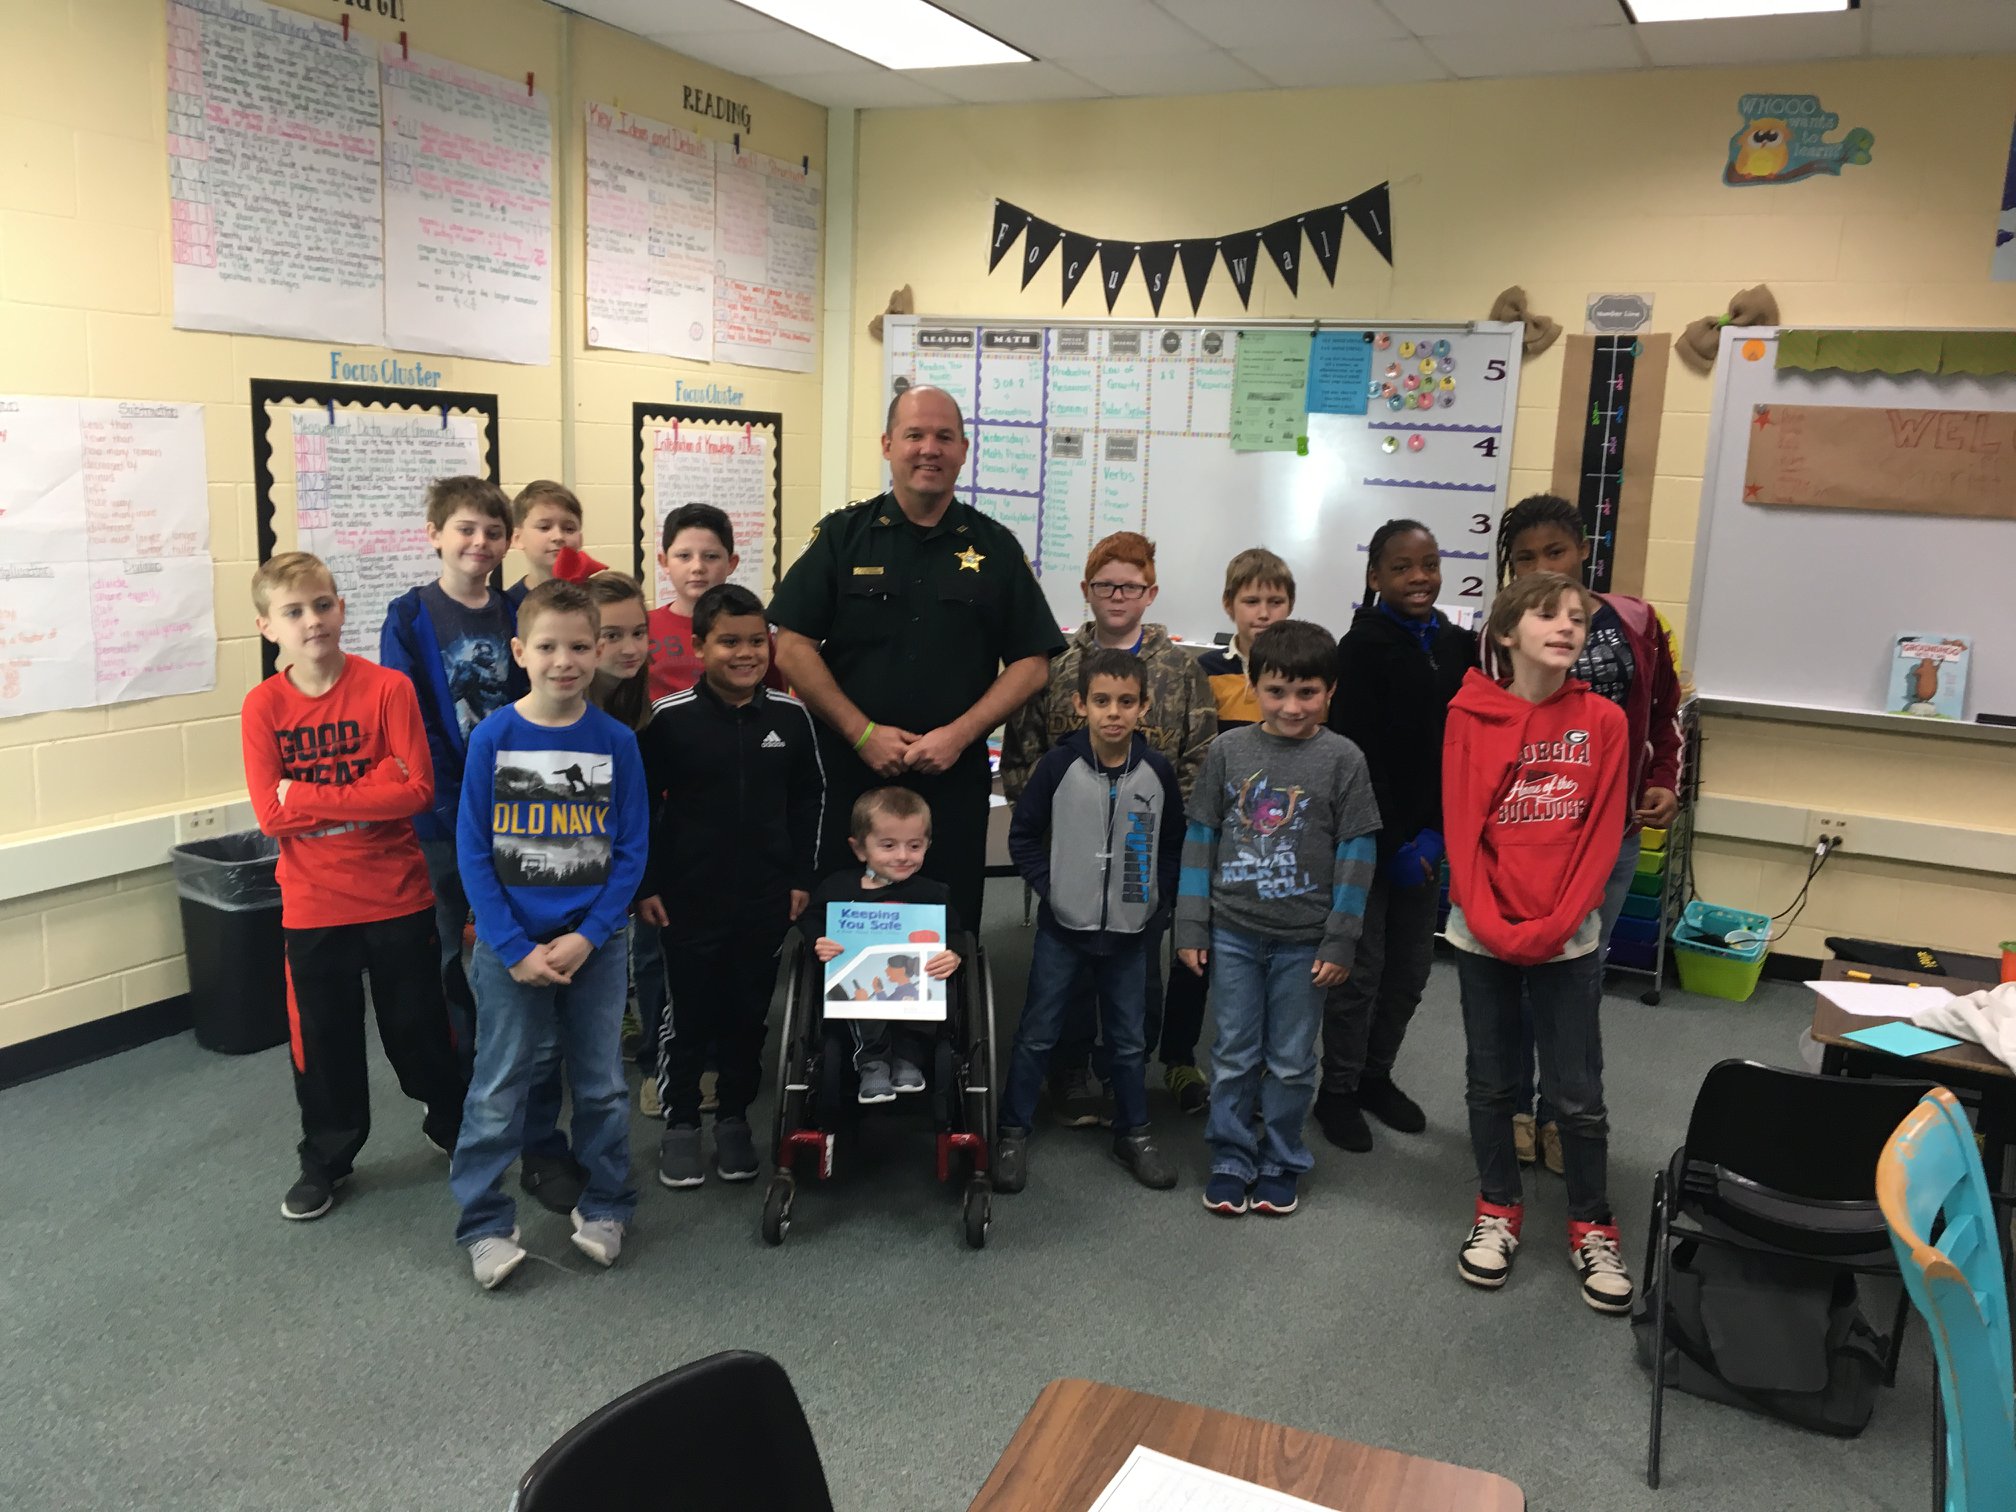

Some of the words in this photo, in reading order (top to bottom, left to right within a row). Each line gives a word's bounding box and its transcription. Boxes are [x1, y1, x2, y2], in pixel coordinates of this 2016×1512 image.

[682, 85, 752, 135] READING
[1742, 97, 1817, 114] WHOOO
[590, 102, 613, 131] Key
[617, 111, 649, 141] Ideas
[652, 128, 671, 149] and
[923, 336, 970, 344] READING
[993, 336, 1031, 344] MATH
[330, 351, 378, 383] Focus
[381, 359, 442, 388] Cluster
[1484, 360, 1506, 381] 5
[675, 380, 704, 403] Focus
[705, 384, 744, 406] Cluster
[117, 402, 178, 418] Subtraction
[1887, 409, 2016, 454] WEL
[1473, 437, 1499, 457] 4
[1103, 466, 1135, 482] Verbs
[1469, 514, 1491, 534] 3
[1459, 576, 1484, 597] 2
[275, 720, 361, 763] GOOD
[1517, 740, 1592, 767] ORGIA
[282, 758, 372, 786] EAT
[1503, 776, 1542, 803] Home
[493, 803, 545, 835] OLD
[551, 803, 610, 835] NAVY
[1122, 811, 1156, 904] PUMA
[838, 919, 865, 930] You
[870, 920, 902, 931] Safe
[841, 908, 900, 920] Keeping
